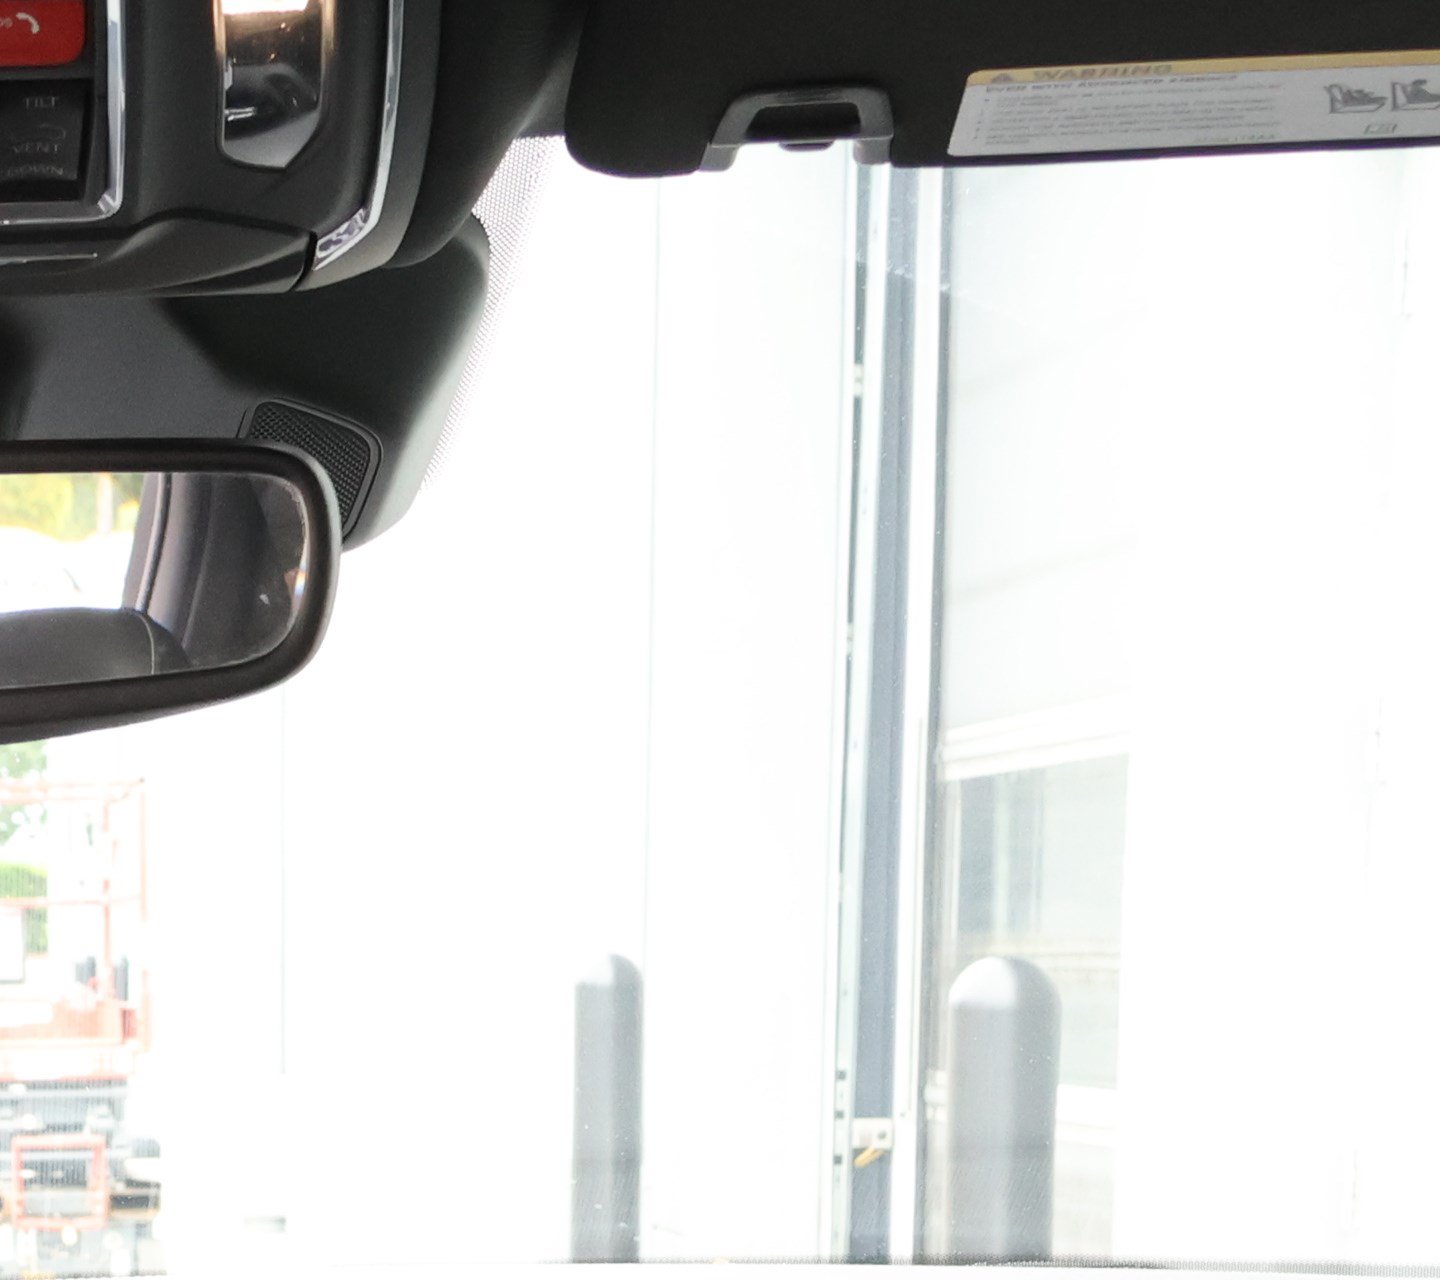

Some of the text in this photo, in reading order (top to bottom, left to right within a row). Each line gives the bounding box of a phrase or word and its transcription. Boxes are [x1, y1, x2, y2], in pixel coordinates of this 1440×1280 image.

[1033, 64, 1173, 81] WARNING
[24, 96, 60, 109] TILT
[12, 143, 64, 154] VENT
